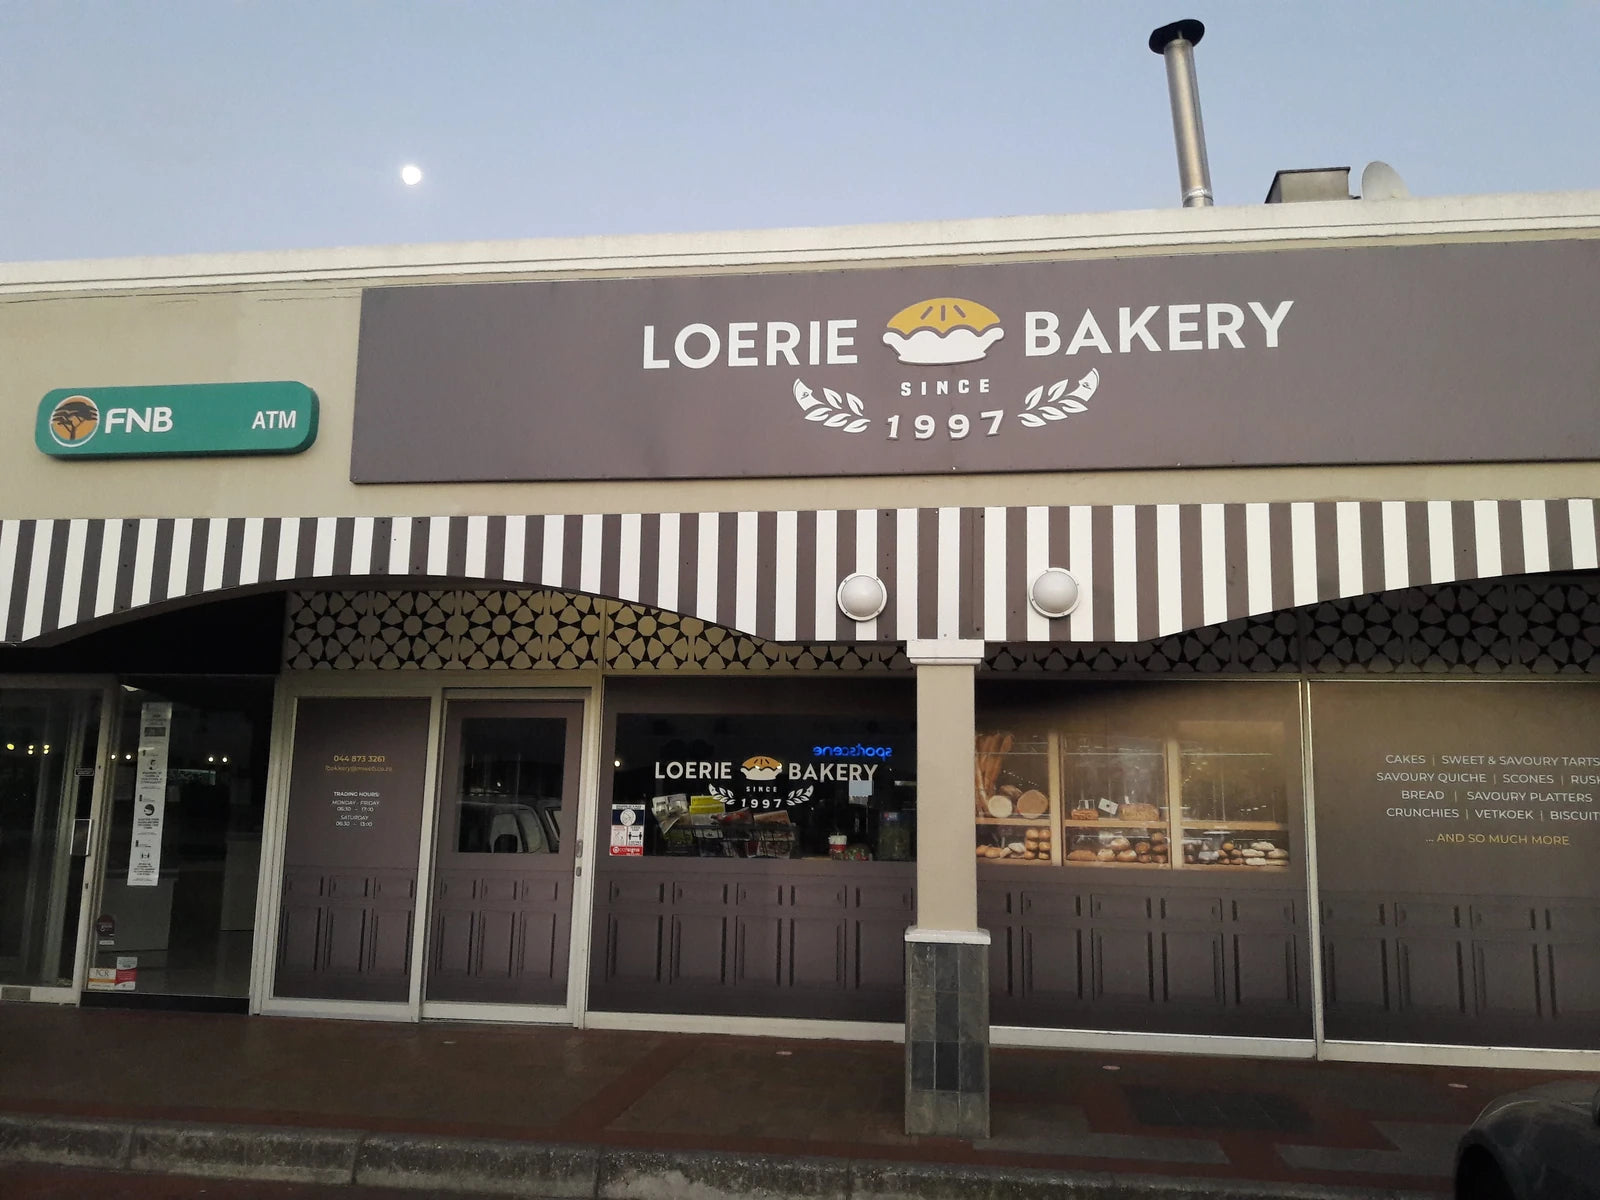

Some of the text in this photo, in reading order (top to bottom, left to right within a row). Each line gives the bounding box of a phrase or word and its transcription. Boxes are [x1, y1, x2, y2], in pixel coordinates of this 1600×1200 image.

[642, 300, 1295, 370] LOERIE BAKERY
[899, 377, 991, 397] SINCE
[104, 406, 297, 434] FNB ATM
[884, 409, 1005, 441] 1997
[1385, 754, 1600, 767] CAKES SWEET & SAVOURY TARTS
[654, 761, 879, 783] LOERIE BAKERY
[1376, 772, 1436, 783] SAVOURY
[1438, 772, 1487, 784] QUICHE
[1502, 773, 1555, 785] SCONES
[745, 785, 778, 793] SINCE
[1401, 790, 1593, 803] BREAD SAVOURY PLATTERS
[741, 798, 782, 809] 1997
[1386, 807, 1460, 819] CRUNCHIES
[1474, 808, 1535, 820] VETKOEK
[1436, 833, 1465, 843] AND
[1468, 833, 1486, 844] SO
[1489, 834, 1528, 845] MUCH
[1531, 835, 1570, 846] MORE
